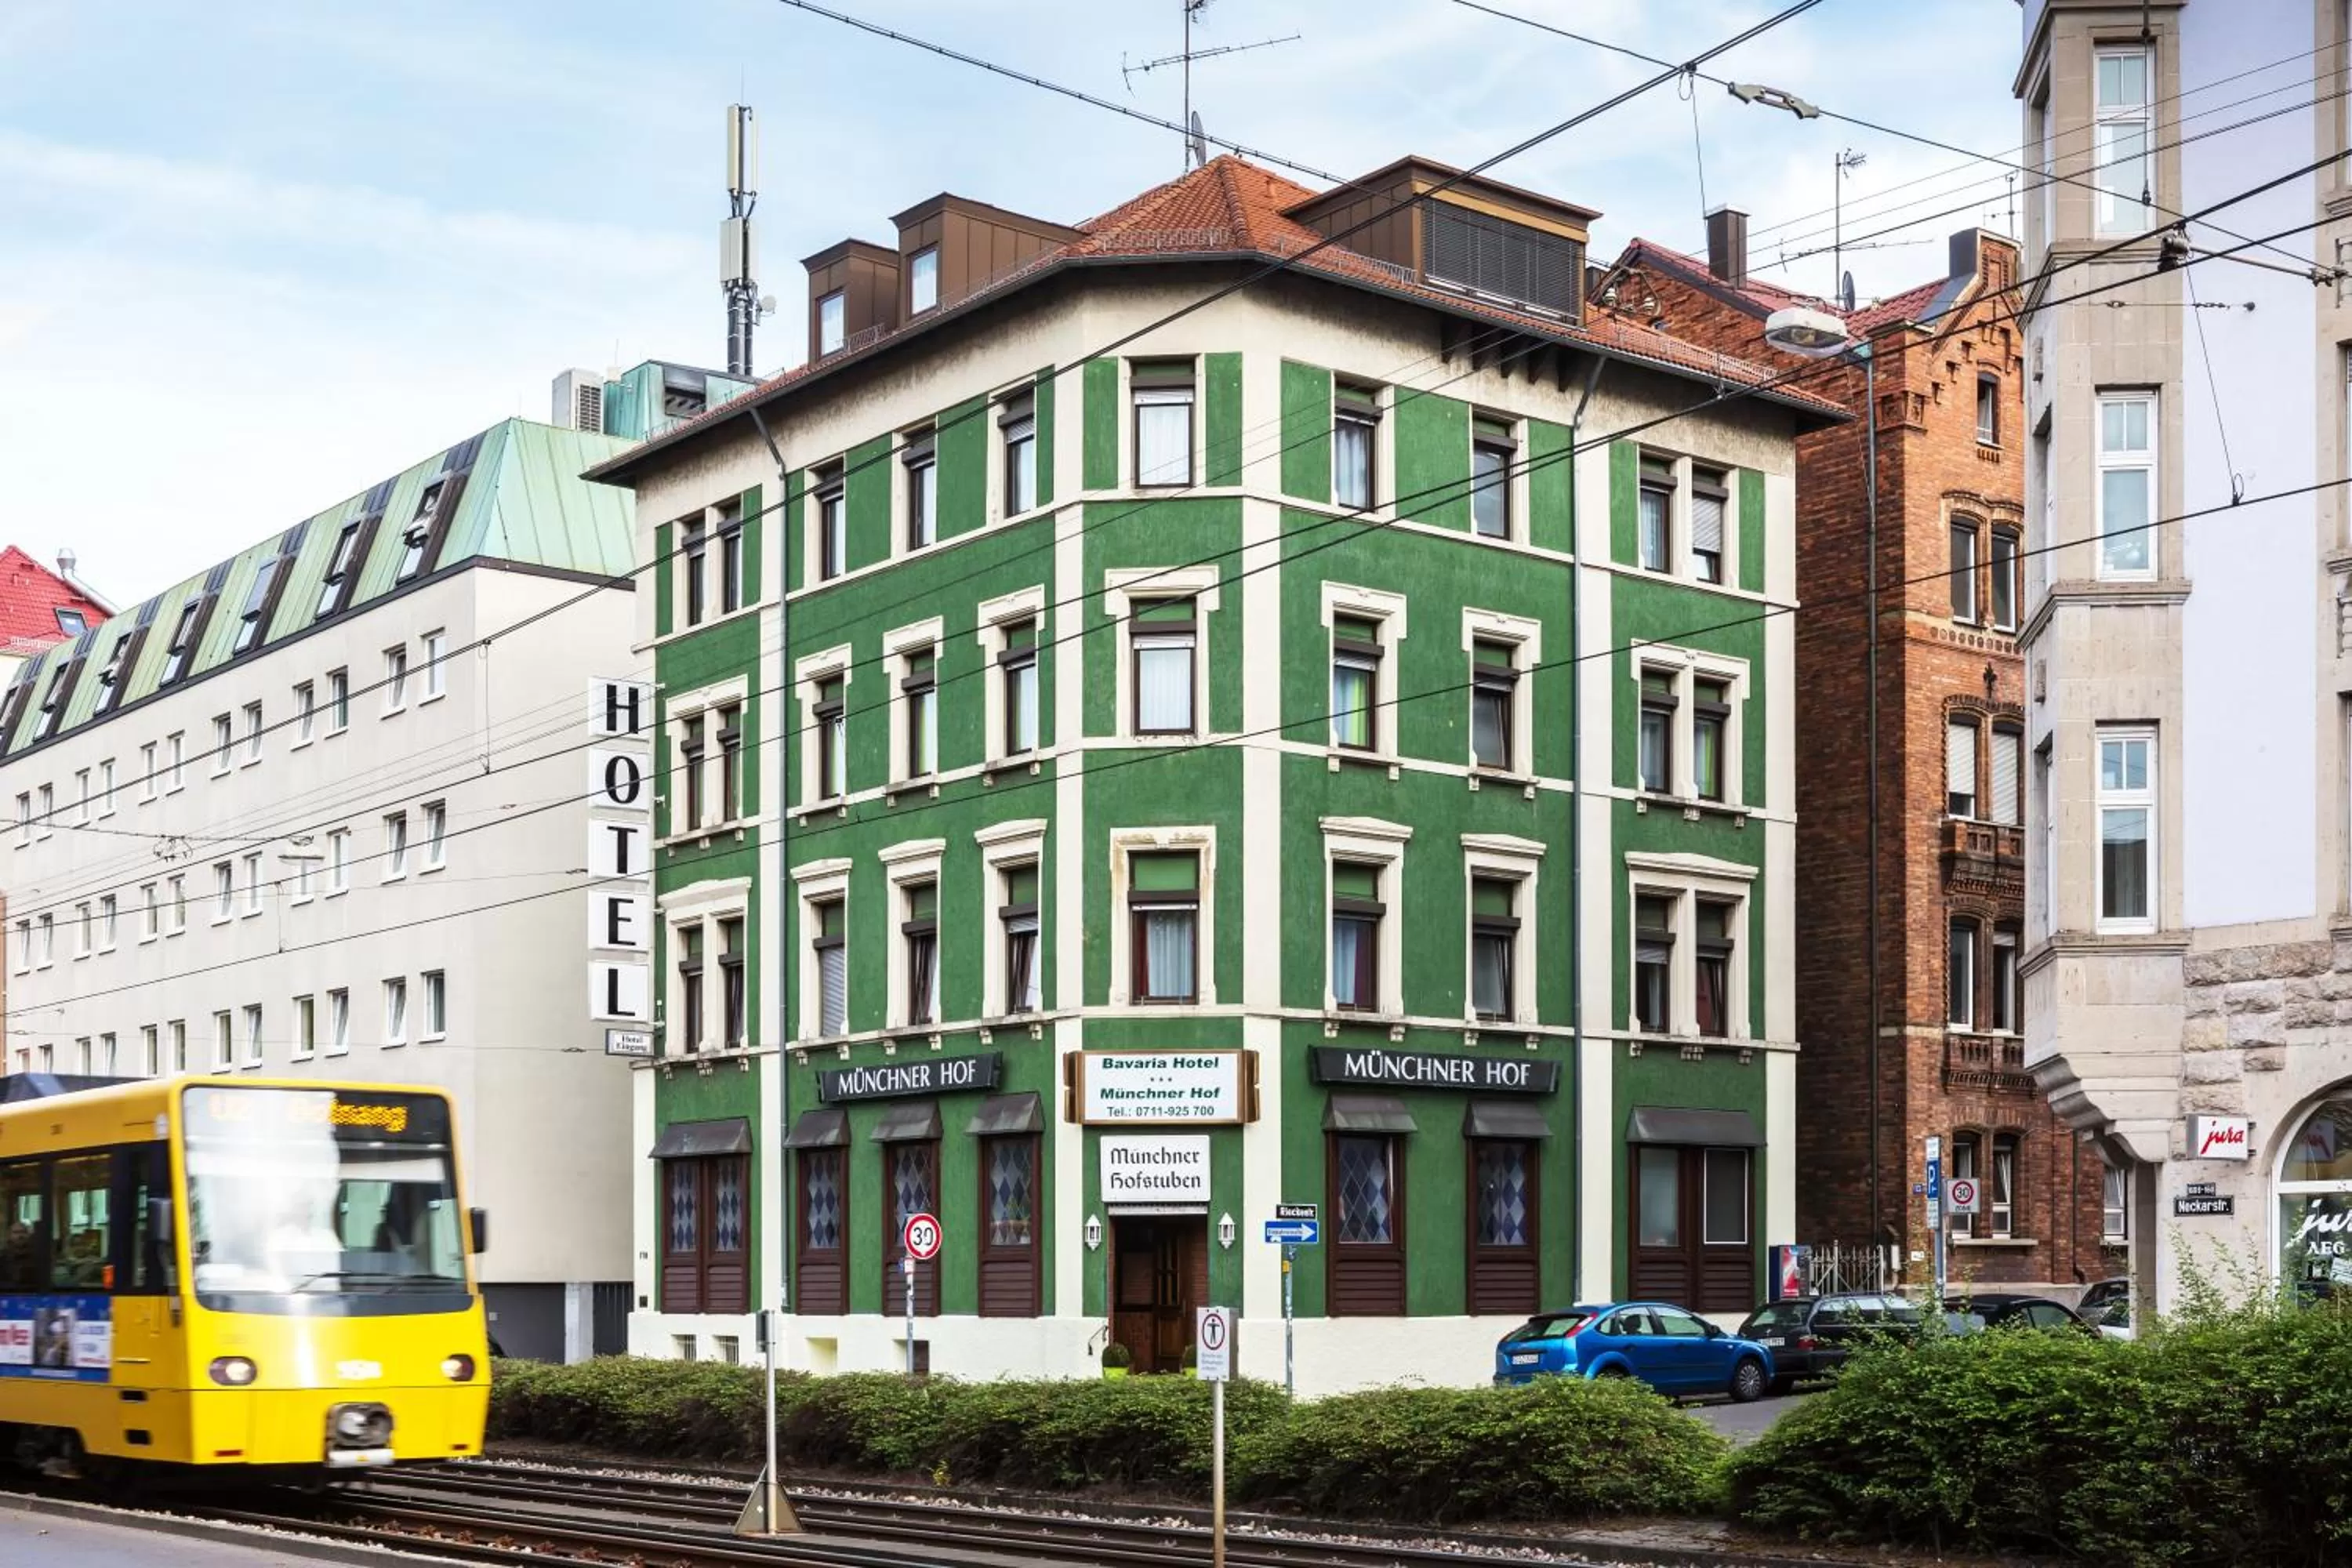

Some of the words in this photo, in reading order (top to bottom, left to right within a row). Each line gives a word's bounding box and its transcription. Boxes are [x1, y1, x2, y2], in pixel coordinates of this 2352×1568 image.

[604, 684, 641, 1016] HOTEL
[1102, 1058, 1167, 1069] Bavaria
[1173, 1057, 1219, 1069] Hotel
[1345, 1051, 1475, 1083] MÜNCHNER
[1486, 1061, 1530, 1085] HOF
[838, 1065, 931, 1094] MÜNCHNER
[941, 1060, 976, 1085] HOF
[1100, 1087, 1185, 1099] Münchner
[1190, 1087, 1221, 1098] Hof
[1107, 1106, 1131, 1117] Tel.:
[1136, 1106, 1189, 1116] 0711-925
[1193, 1106, 1214, 1116] 700
[2200, 1120, 2245, 1155] jura
[1111, 1146, 1200, 1164] Münchner
[1111, 1171, 1201, 1189] Hofstuben
[1956, 1186, 1970, 1199] 30
[913, 1227, 934, 1247] 30
[2307, 1241, 2346, 1255] AEG
